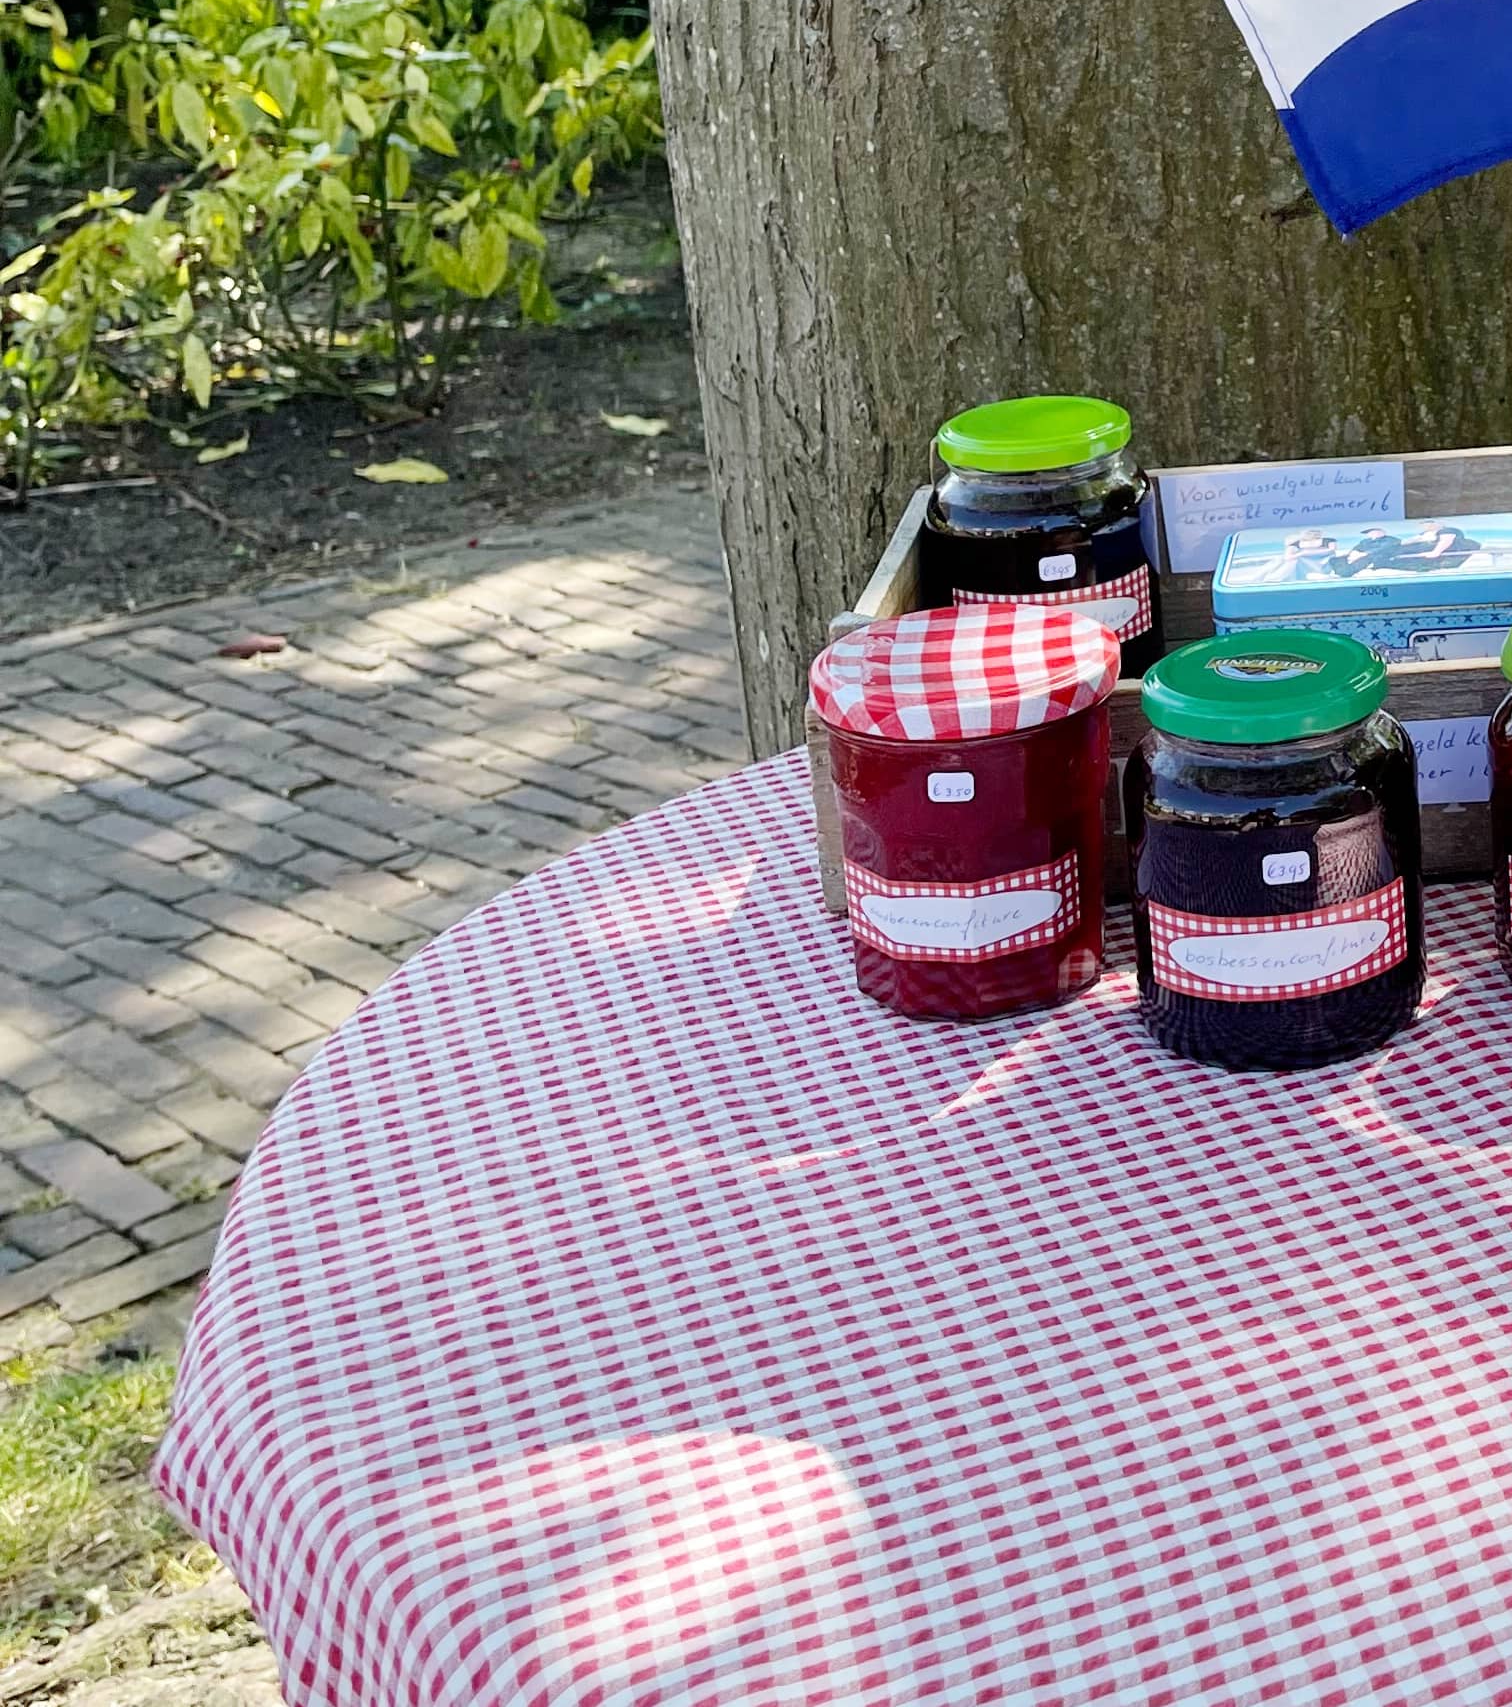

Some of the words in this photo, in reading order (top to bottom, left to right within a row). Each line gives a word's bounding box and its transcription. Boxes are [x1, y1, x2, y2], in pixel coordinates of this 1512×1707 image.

[1180, 485, 1226, 505] Voor
[1237, 471, 1325, 497] wisselgeld
[1334, 469, 1375, 485] kunt
[1273, 506, 1294, 521] op
[1301, 499, 1367, 514] nummer
[1360, 585, 1389, 598] 200g
[1414, 726, 1457, 756] geld
